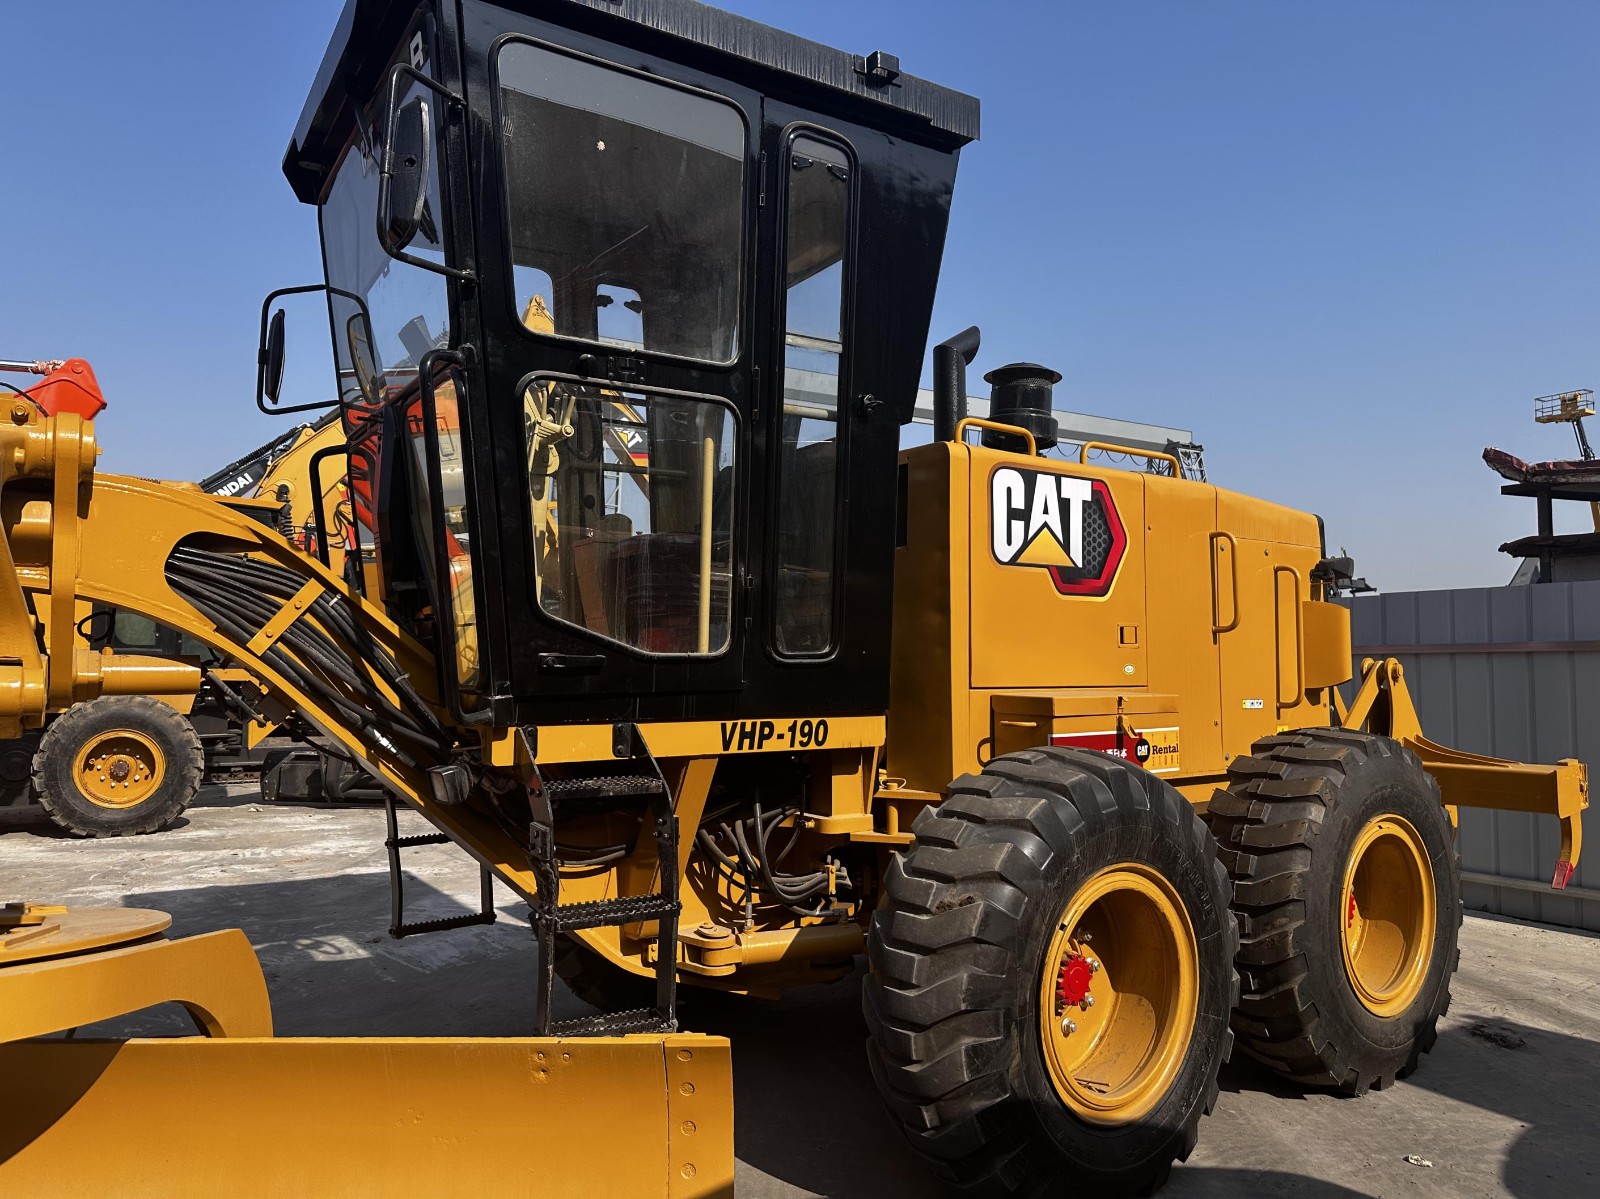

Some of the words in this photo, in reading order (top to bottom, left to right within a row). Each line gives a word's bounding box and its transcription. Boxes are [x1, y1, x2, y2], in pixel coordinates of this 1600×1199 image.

[212, 472, 254, 496] NDAI
[992, 468, 1092, 568] CAT
[720, 719, 829, 752] VHP-190
[1137, 744, 1149, 756] CAT
[1151, 743, 1179, 755] Rental
